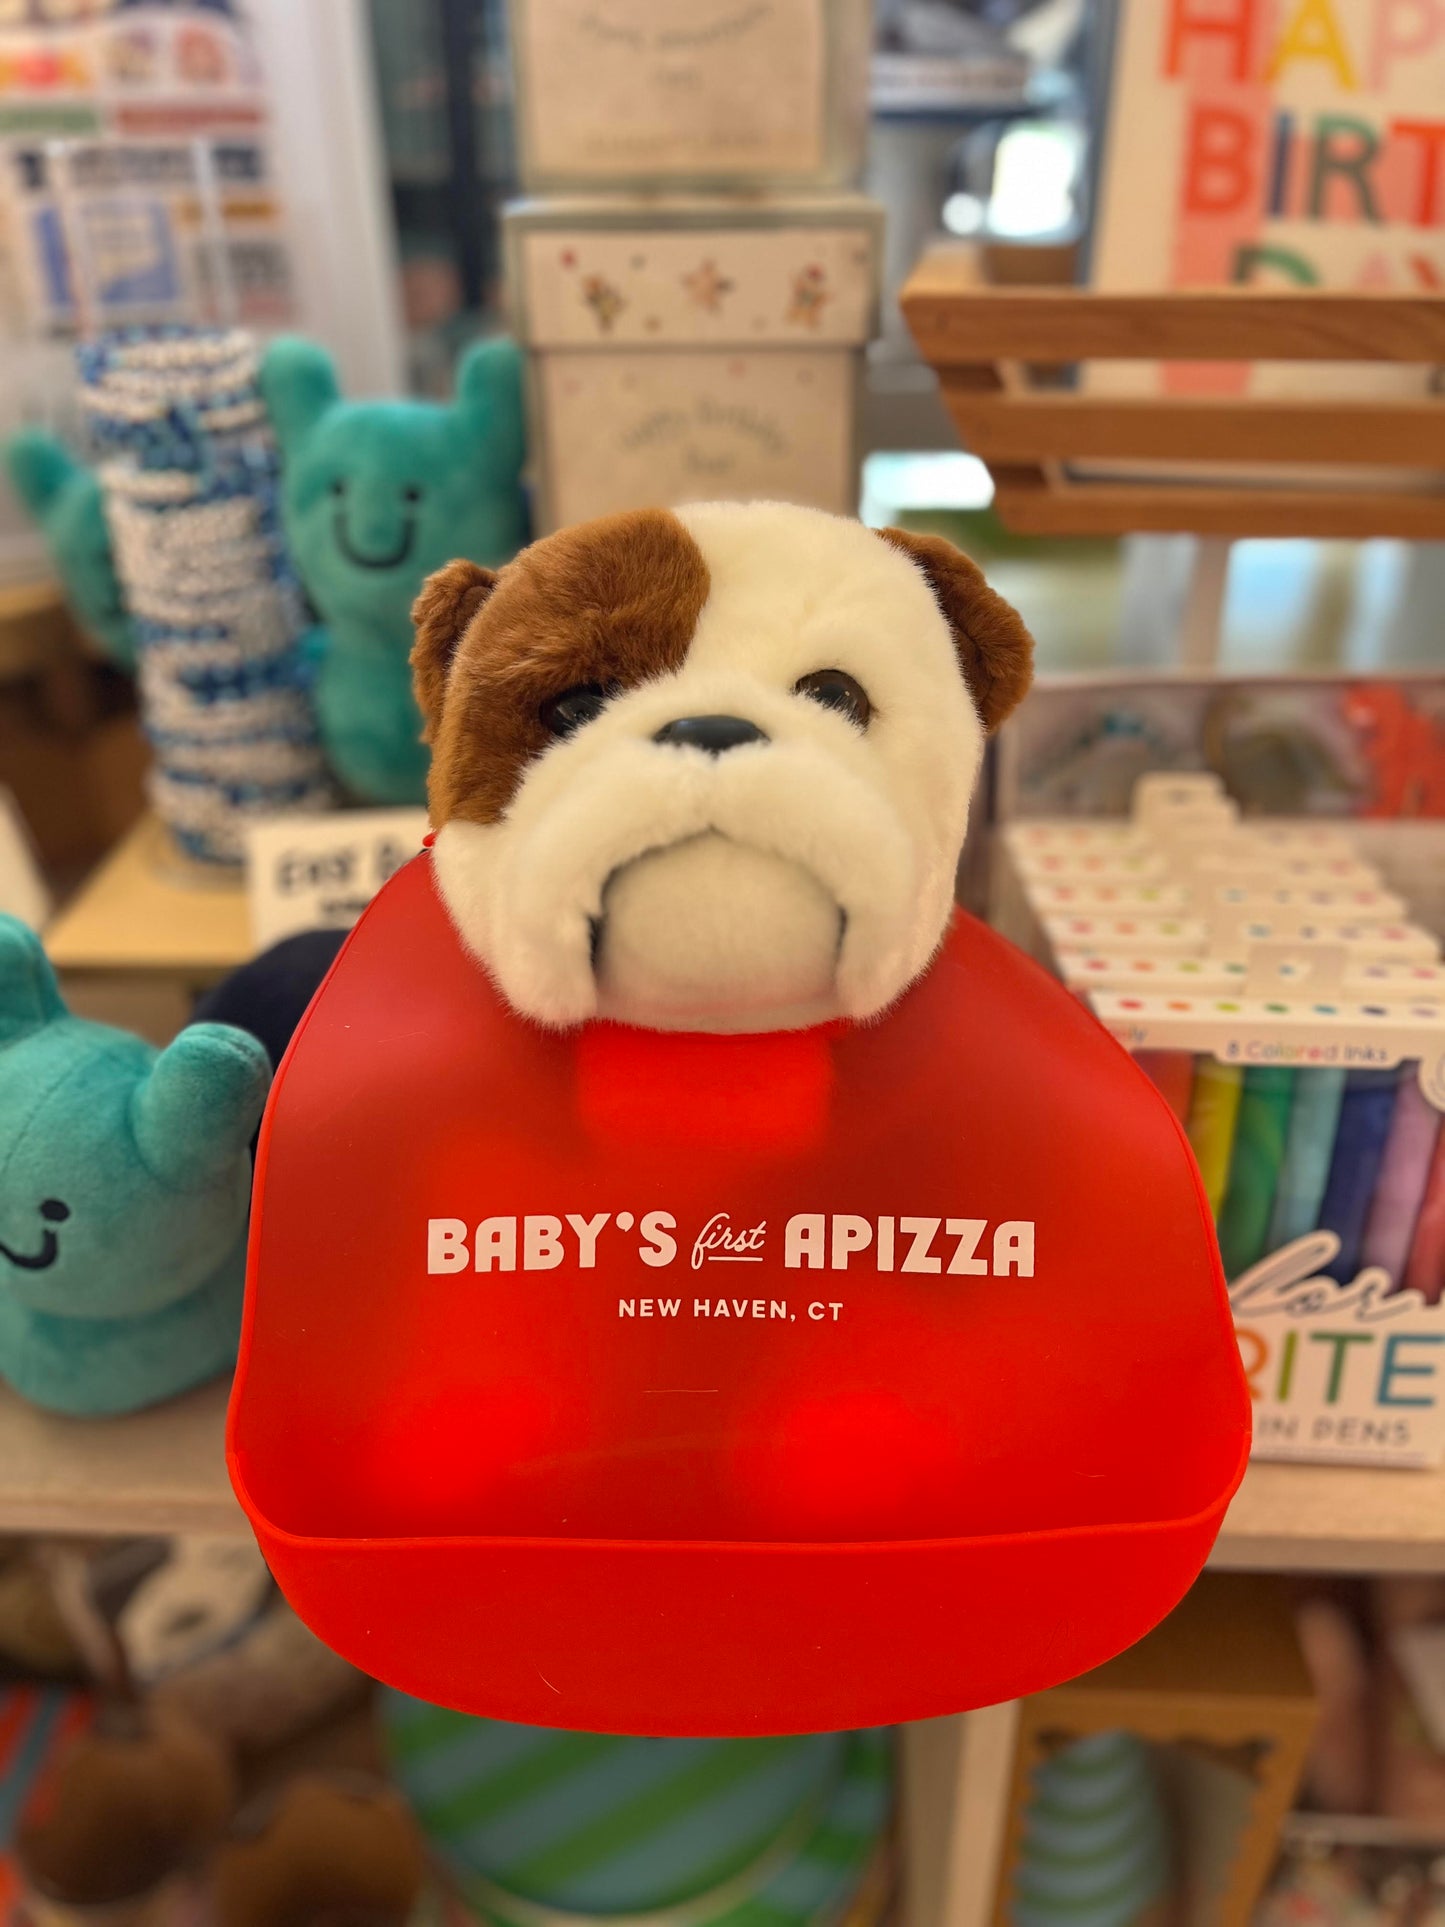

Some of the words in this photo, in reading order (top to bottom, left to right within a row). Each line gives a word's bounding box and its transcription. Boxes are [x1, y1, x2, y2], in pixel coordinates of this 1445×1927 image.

[1246, 1041, 1338, 1061] Colored
[427, 1210, 678, 1275] BABY'S
[690, 1212, 767, 1270] first
[784, 1212, 1035, 1278] APIZZA
[618, 1298, 682, 1318] NEW
[693, 1299, 796, 1322] HAVEN,
[807, 1301, 844, 1321] CT
[1312, 1416, 1411, 1446] PENS
